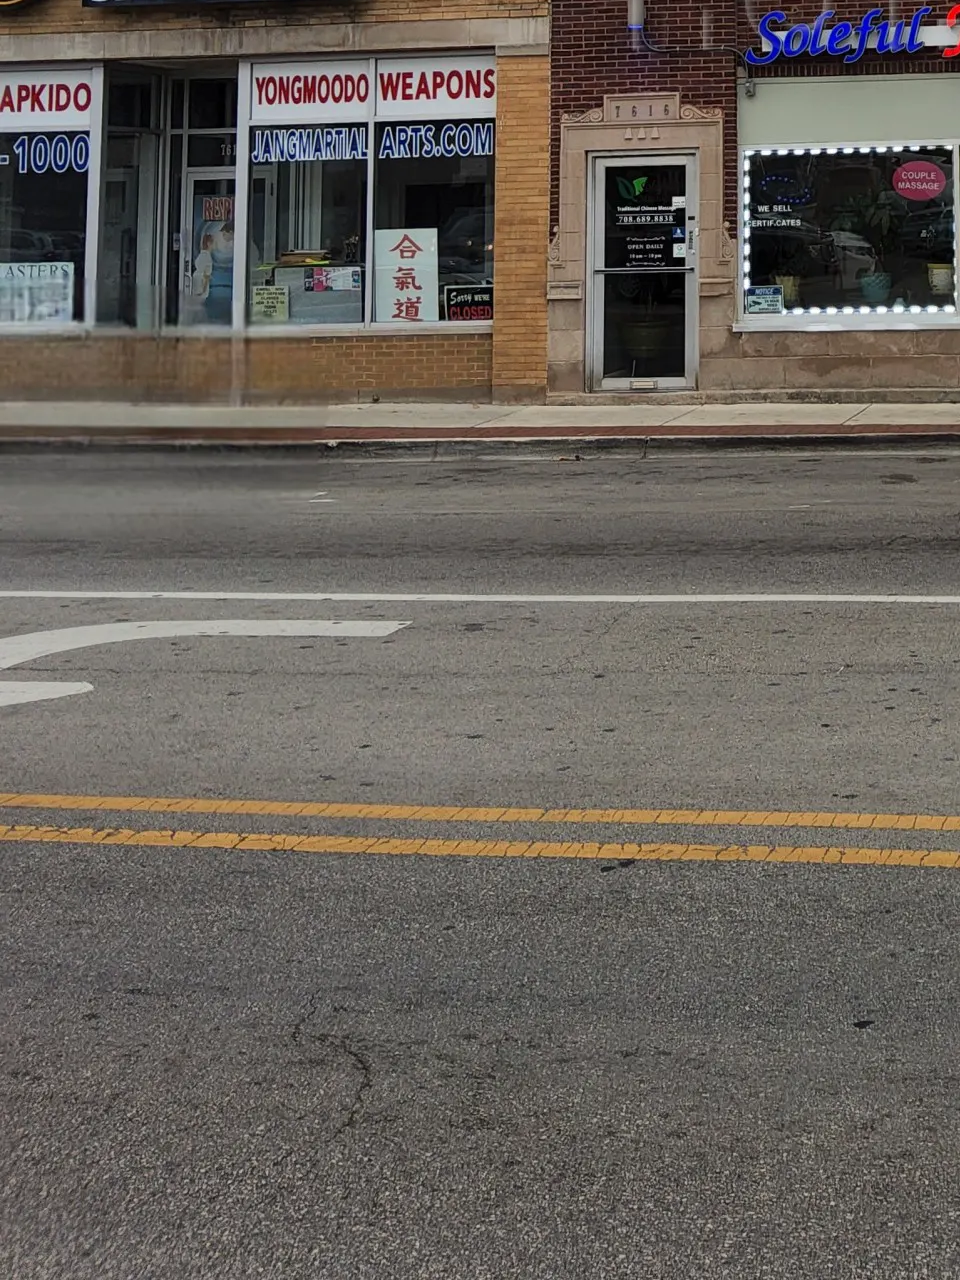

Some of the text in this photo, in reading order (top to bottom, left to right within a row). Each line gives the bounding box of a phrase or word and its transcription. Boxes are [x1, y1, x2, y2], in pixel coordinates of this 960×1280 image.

[745, 6, 933, 65] Soleful
[256, 73, 369, 106] YONGMOODO
[379, 69, 495, 101] WEAPONS
[0, 82, 92, 113] APKIDO
[615, 104, 669, 118] 7616
[251, 123, 494, 163] JANGMARTIAL ARTS.COM
[901, 171, 937, 180] COUPLE
[898, 181, 941, 190] MASSAGE
[757, 204, 793, 212] WE SELL
[450, 292, 491, 305] Sorry WE'RE
[450, 306, 492, 320] CLOSED
